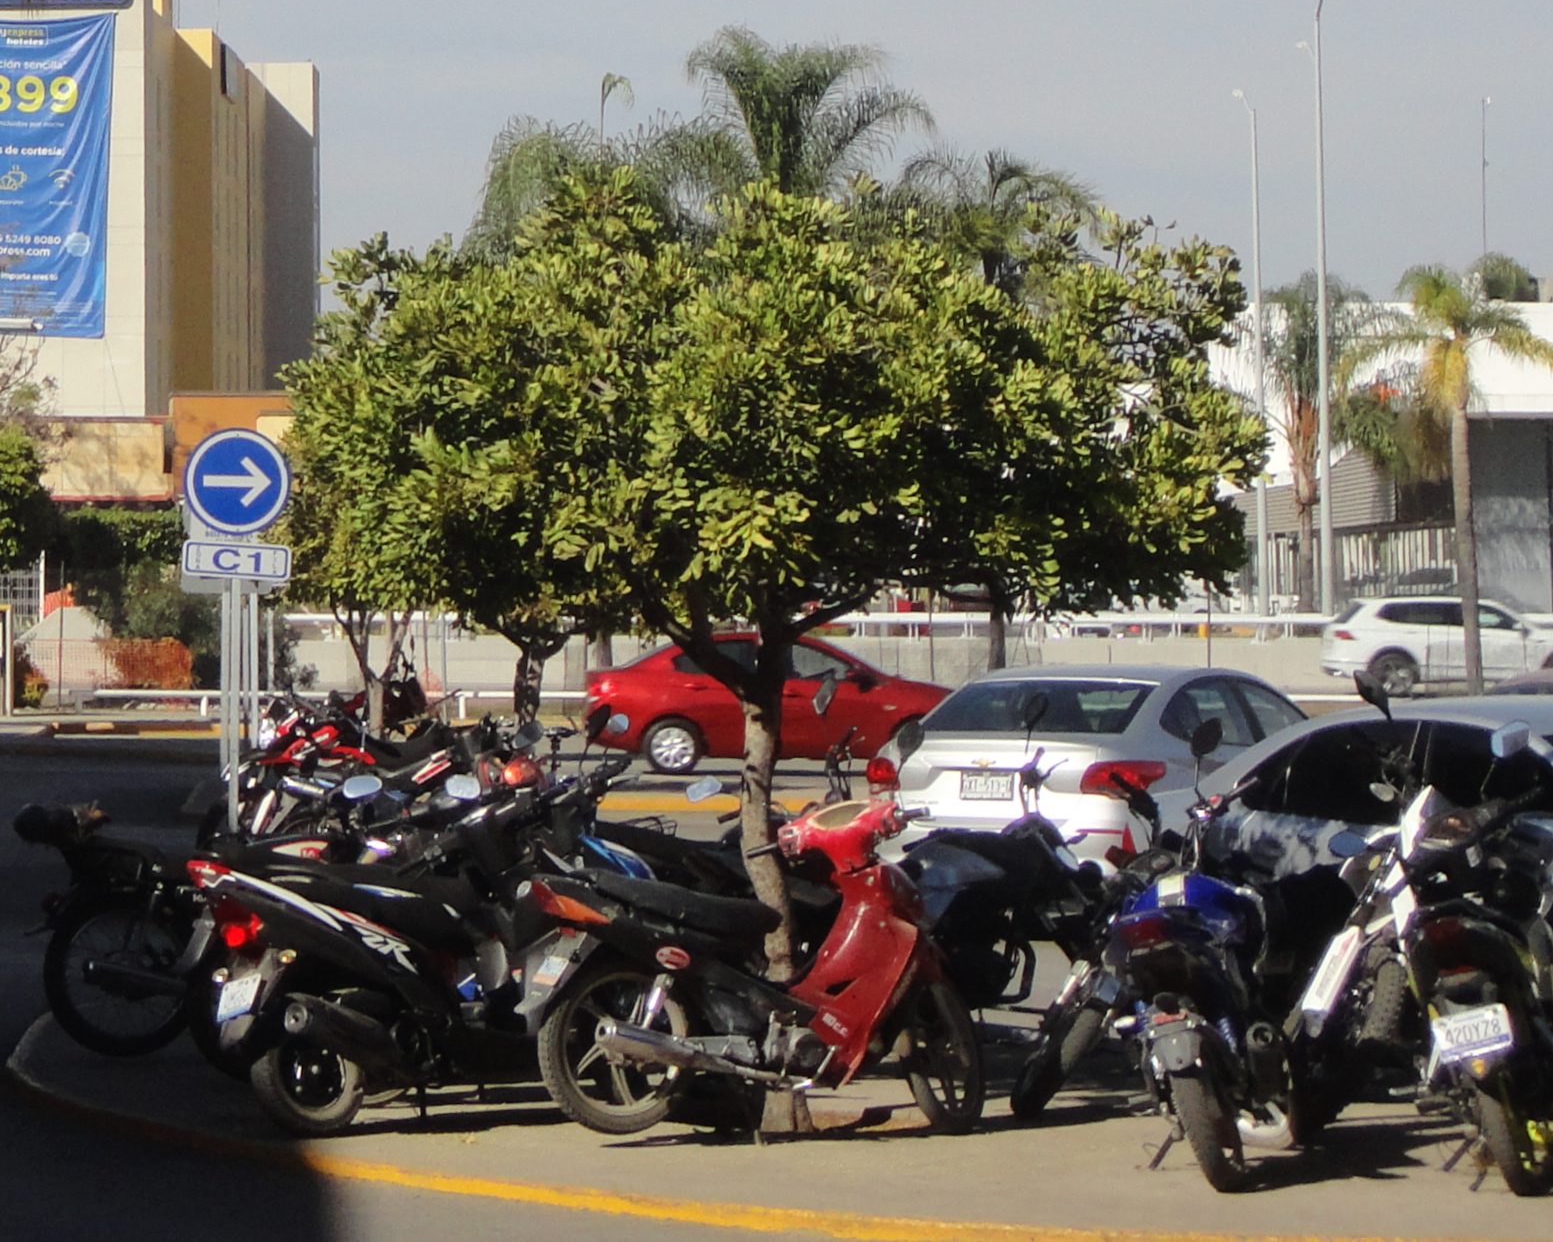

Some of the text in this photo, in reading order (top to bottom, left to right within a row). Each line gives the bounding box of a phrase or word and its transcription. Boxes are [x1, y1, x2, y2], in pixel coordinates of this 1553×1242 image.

[6, 37, 45, 46] hoteles
[4, 144, 19, 155] de
[212, 548, 262, 573] C1
